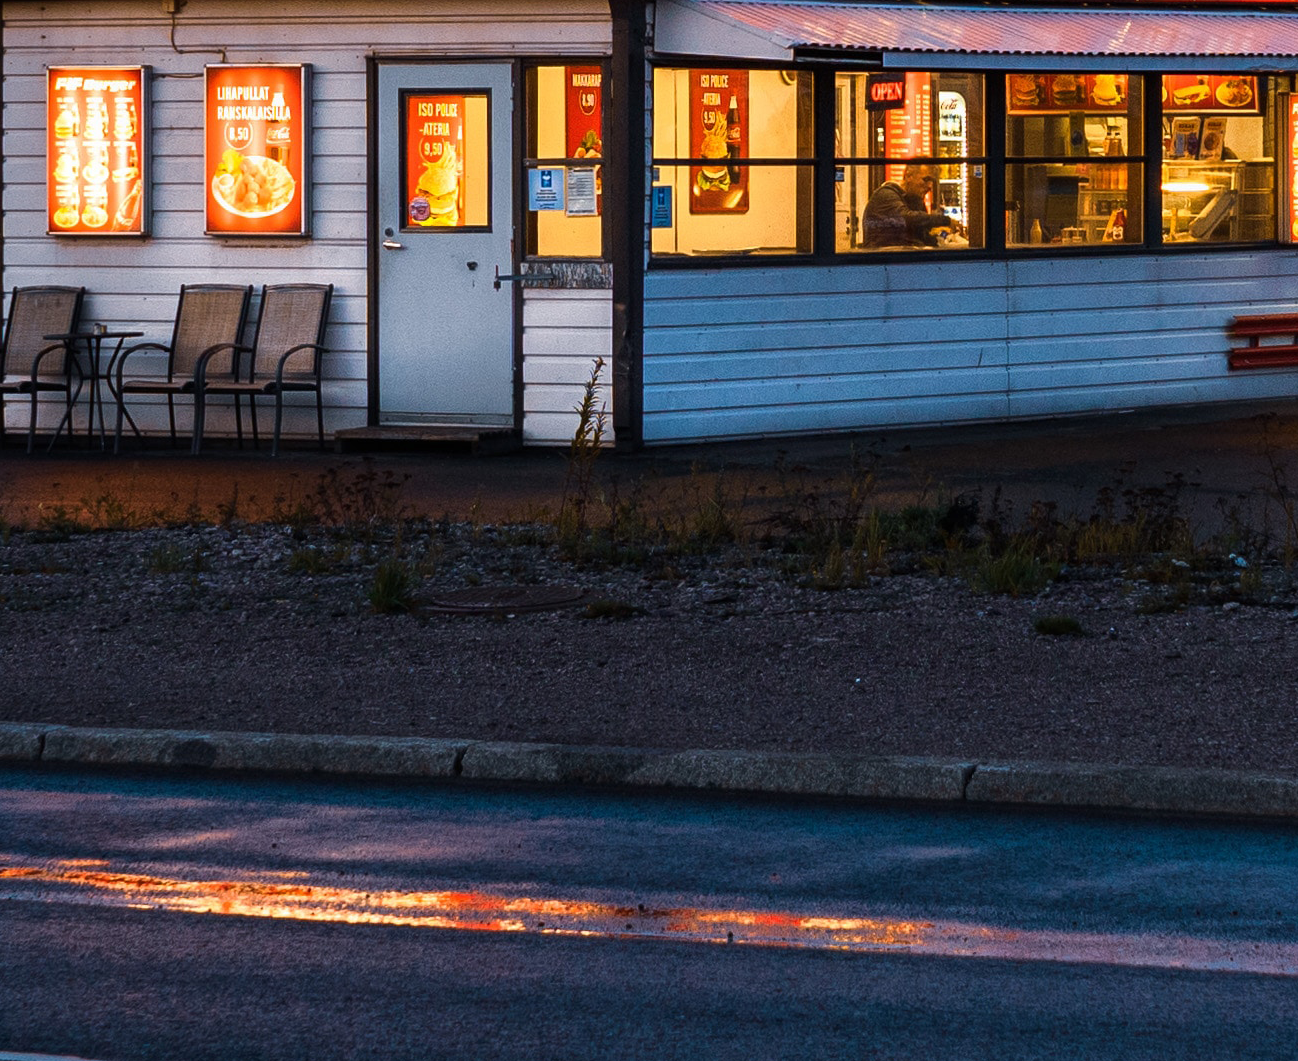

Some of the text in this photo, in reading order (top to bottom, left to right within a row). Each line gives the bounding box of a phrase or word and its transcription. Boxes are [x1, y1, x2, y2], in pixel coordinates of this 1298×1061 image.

[217, 86, 269, 100] LIHAPULLAT
[870, 81, 904, 102] OPEN
[217, 106, 291, 120] RANSKALAISILLA
